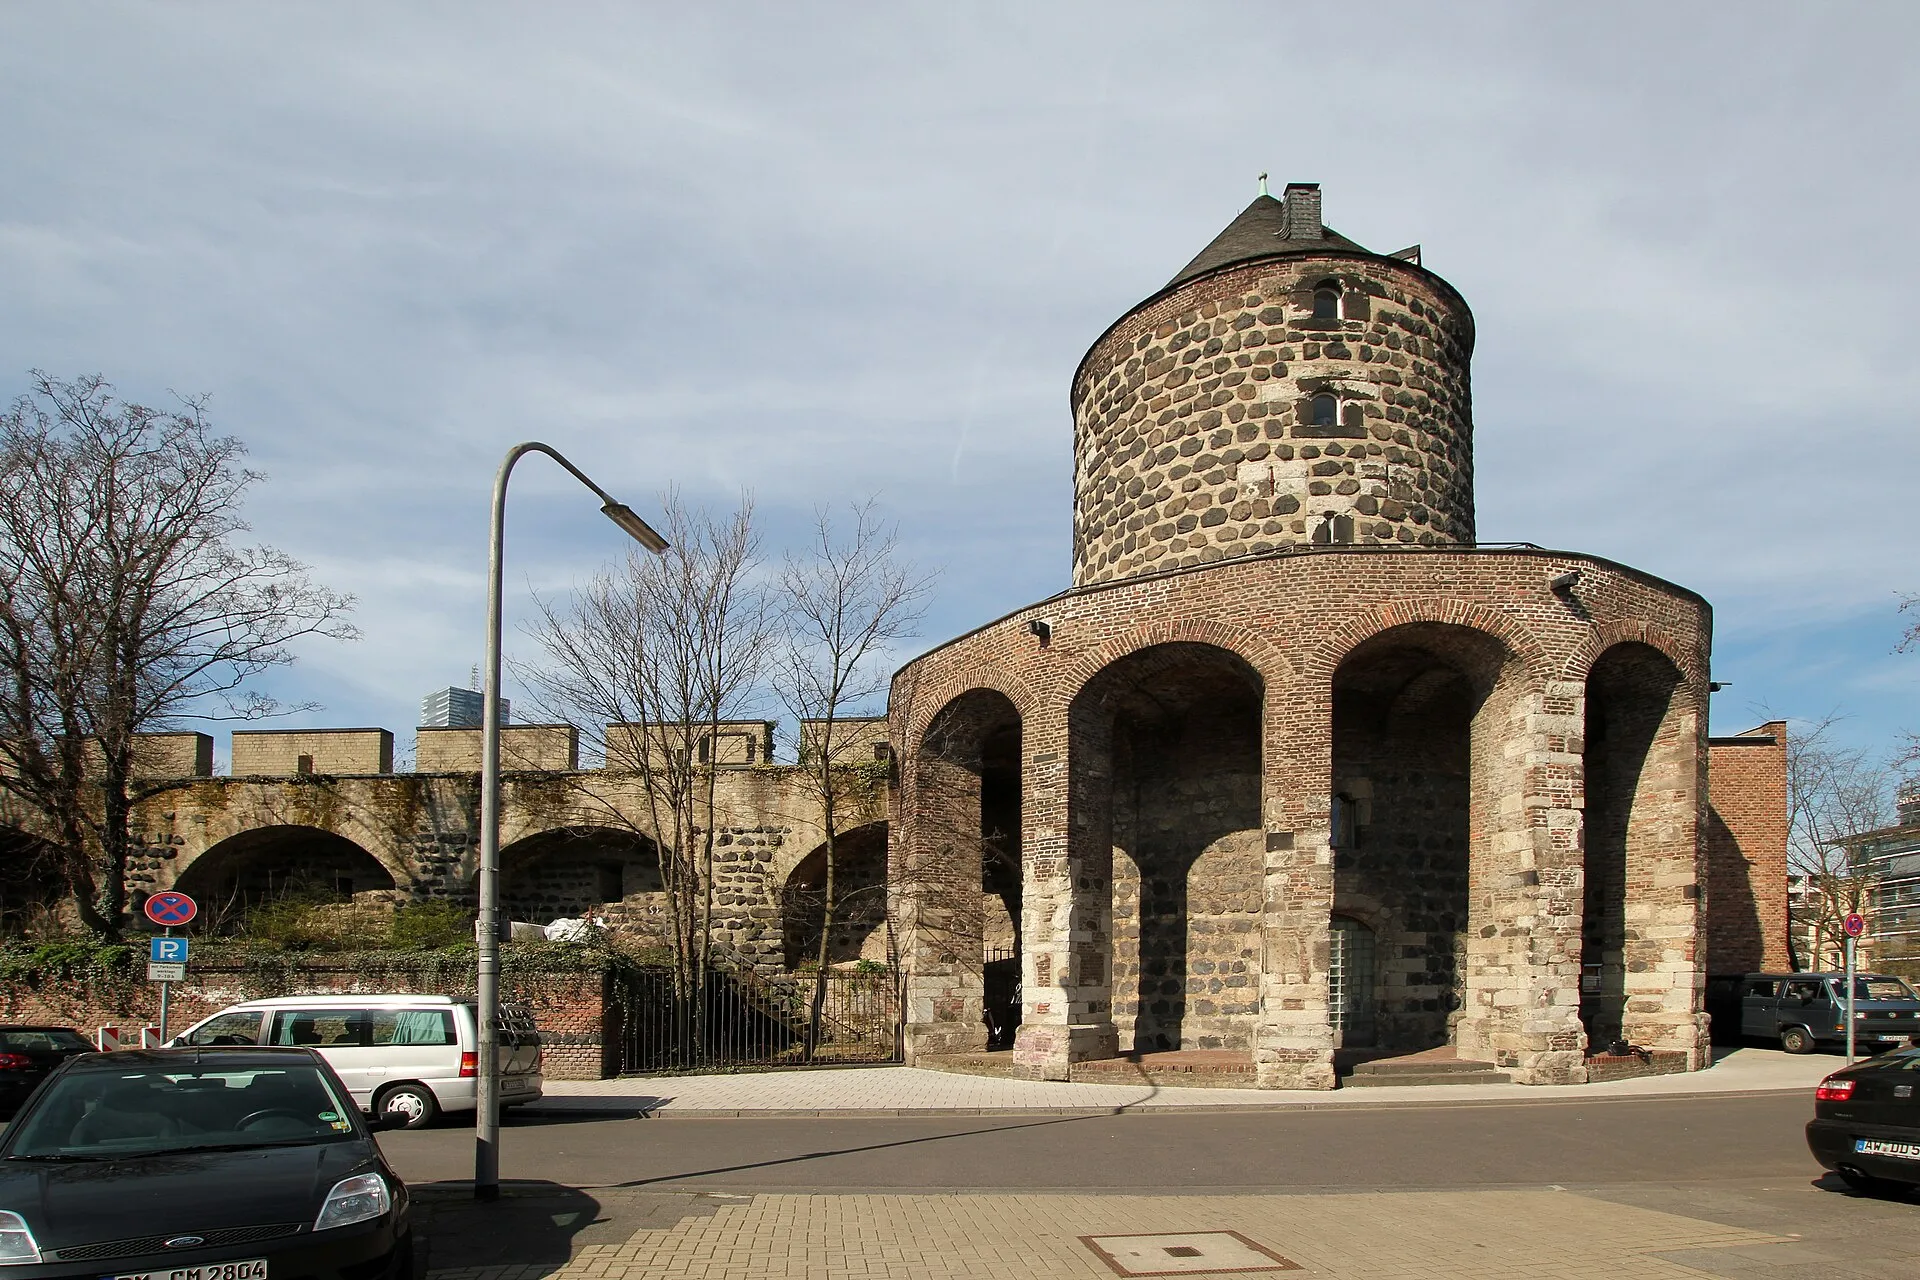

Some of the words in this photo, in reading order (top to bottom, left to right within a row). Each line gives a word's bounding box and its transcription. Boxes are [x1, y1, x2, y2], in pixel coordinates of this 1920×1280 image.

[160, 941, 179, 958] P
[1865, 1140, 1880, 1151] AW
[207, 1261, 265, 1280] 2804
